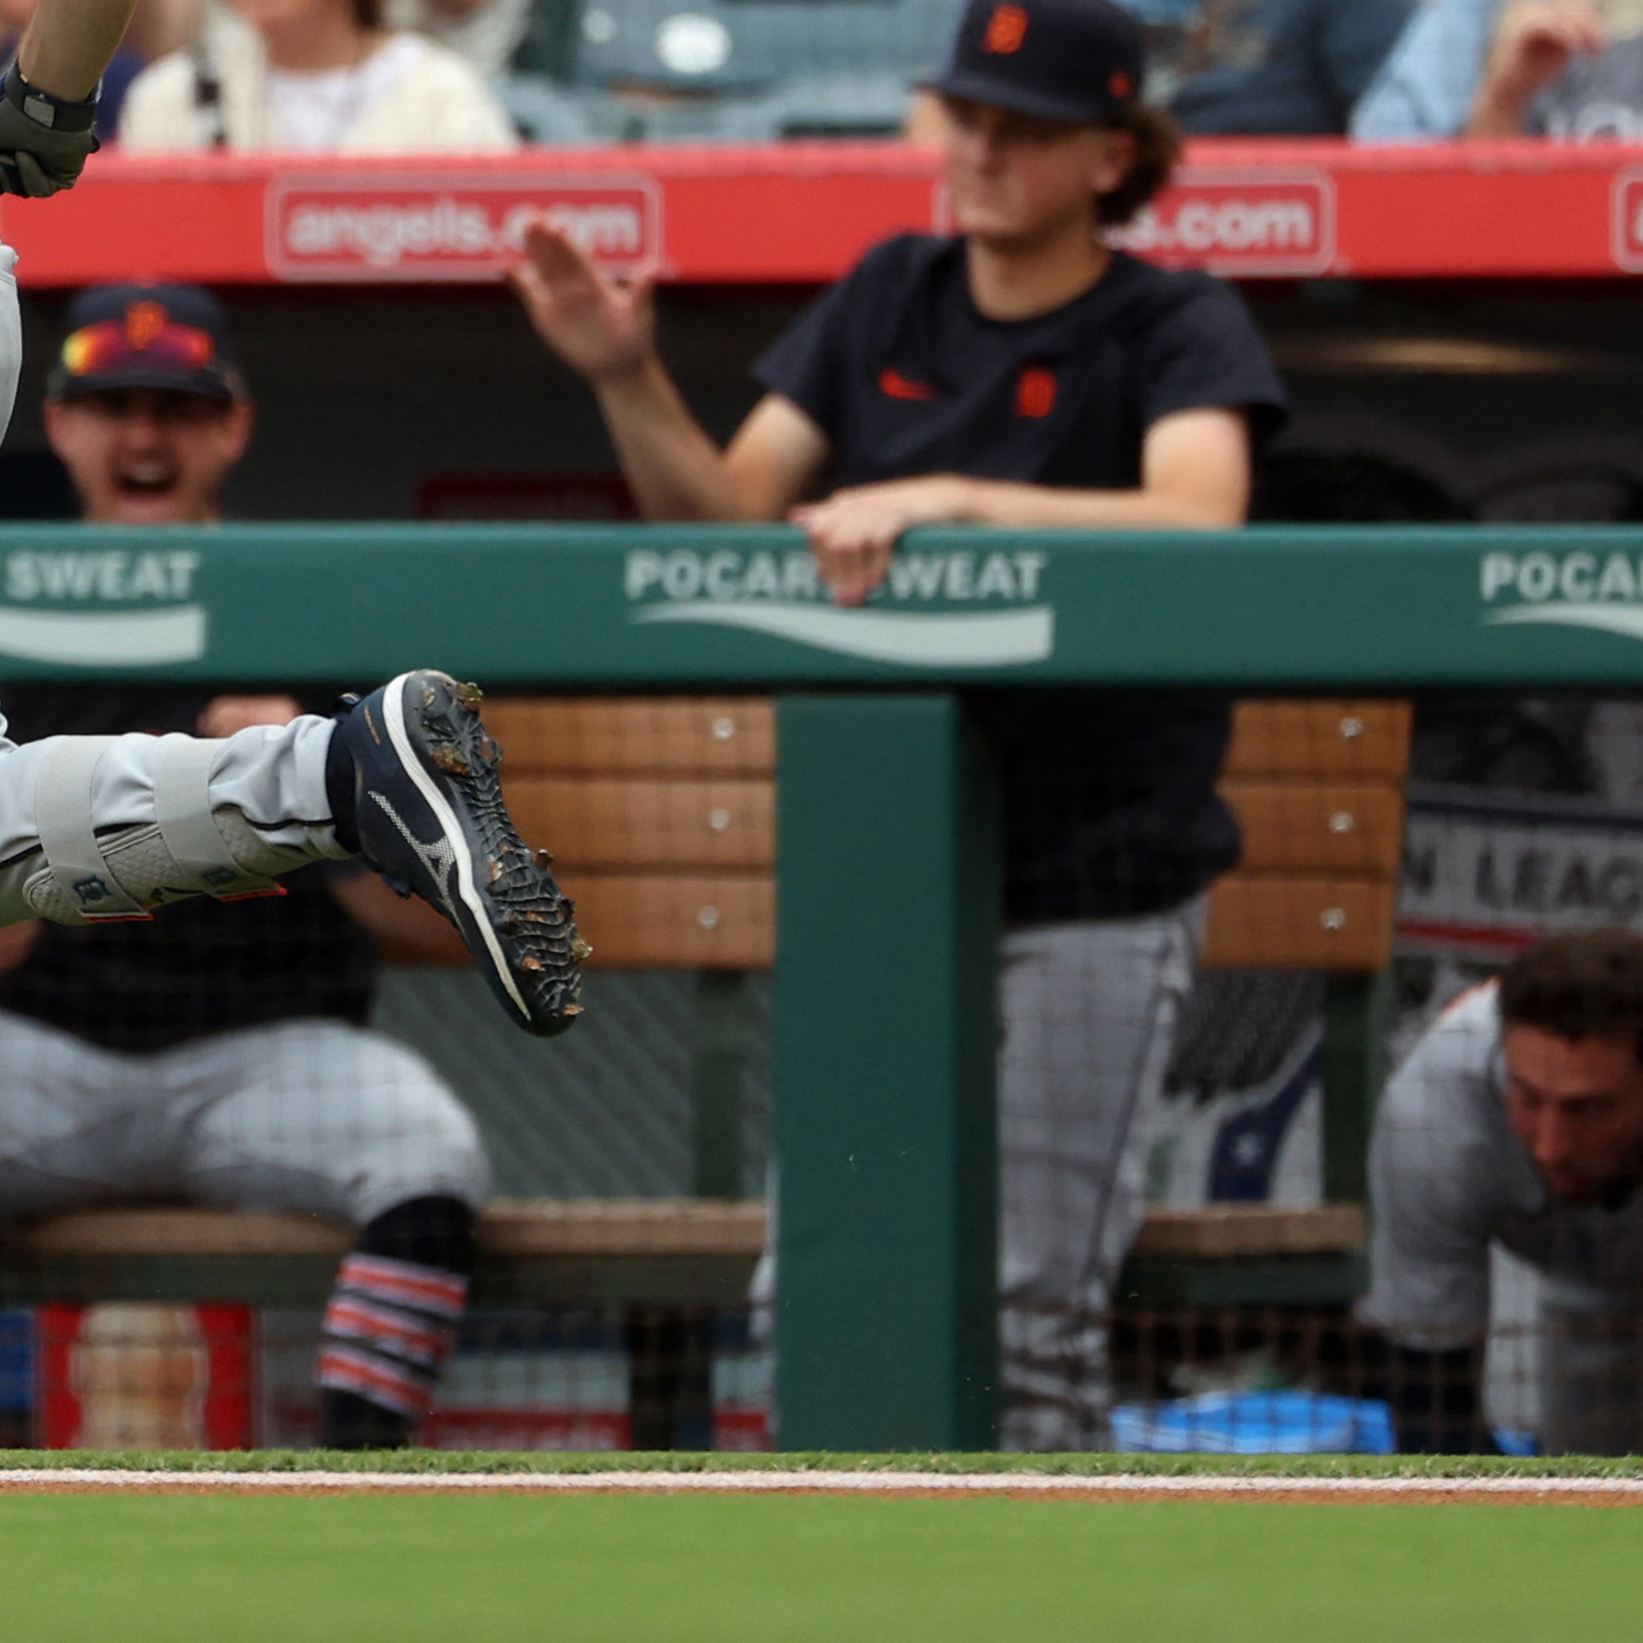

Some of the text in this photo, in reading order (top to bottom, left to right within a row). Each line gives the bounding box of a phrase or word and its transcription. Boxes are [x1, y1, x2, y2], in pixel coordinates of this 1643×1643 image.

[5, 548, 201, 601] SWEAT
[624, 548, 1045, 601] POCAR WEAT
[1481, 549, 1643, 603] POCA
